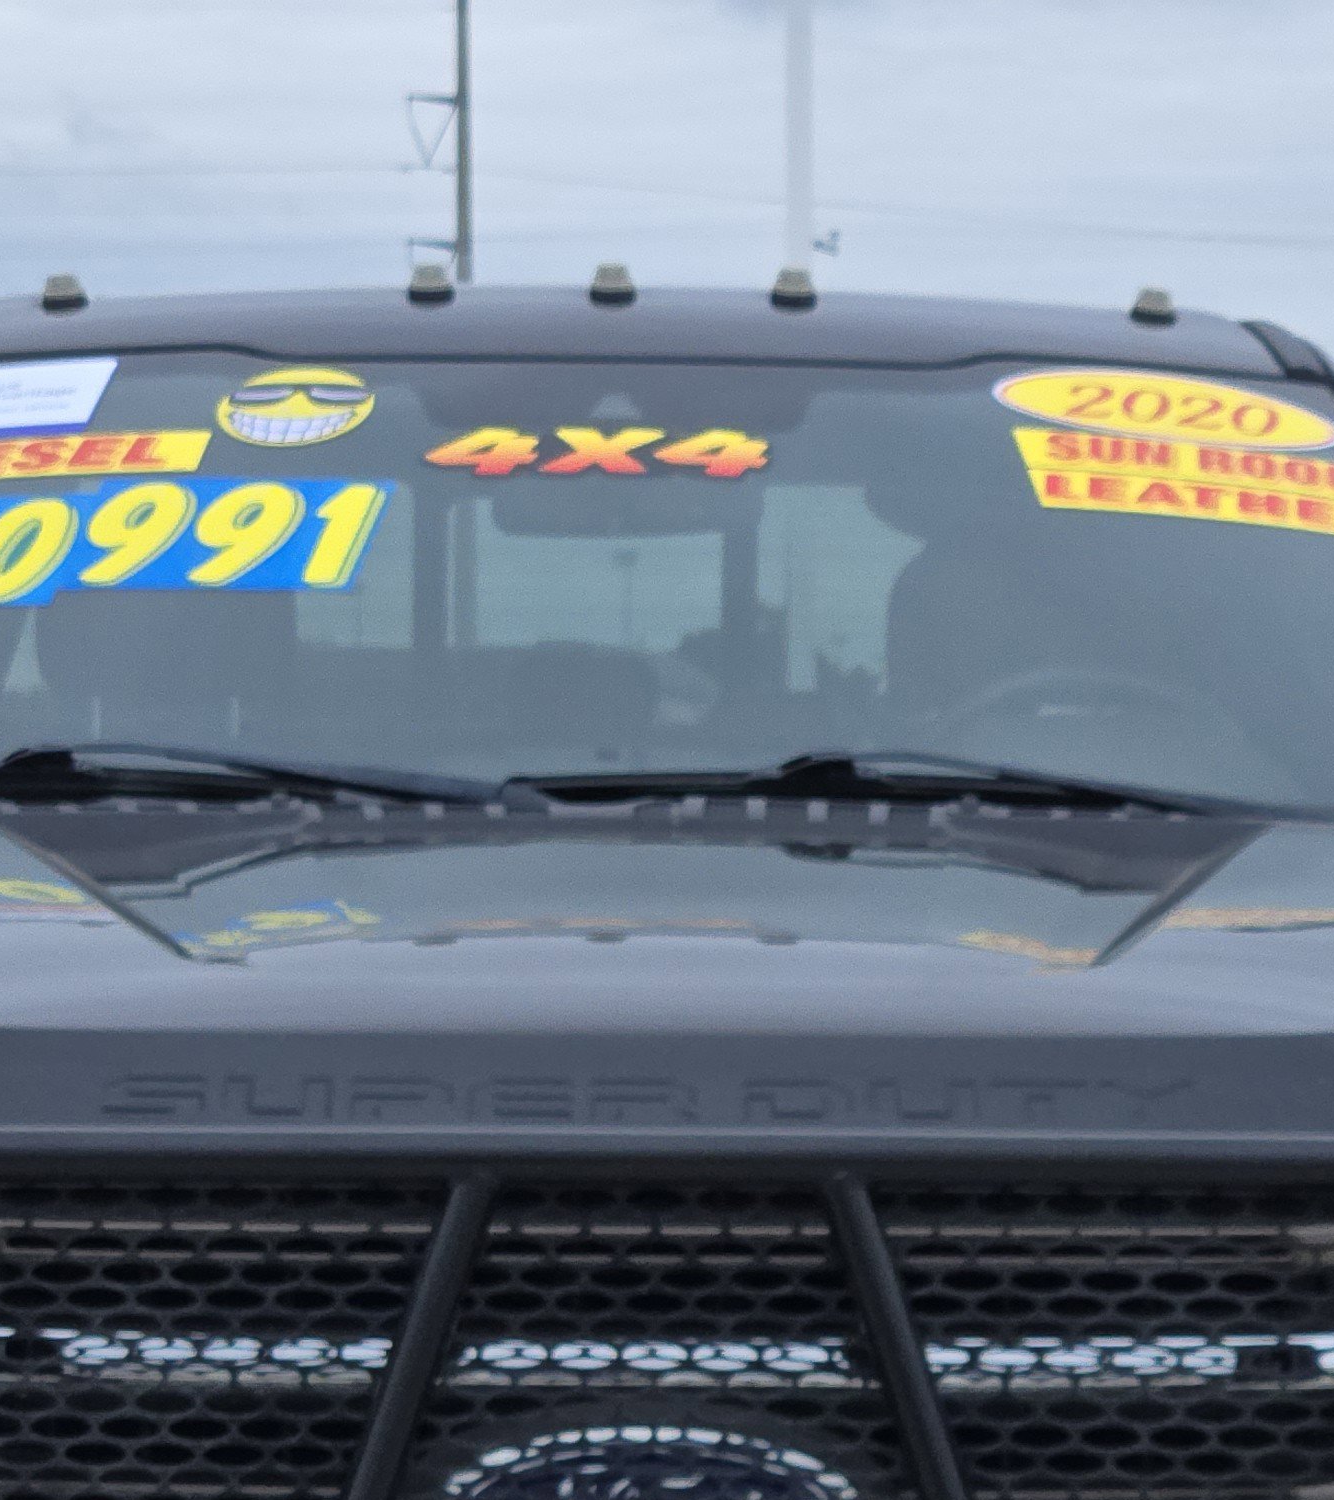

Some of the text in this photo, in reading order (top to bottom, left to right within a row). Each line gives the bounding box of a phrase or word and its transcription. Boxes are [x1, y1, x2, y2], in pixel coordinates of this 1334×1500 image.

[1068, 383, 1281, 437] 2020
[423, 426, 769, 478] 4X4
[1045, 433, 1175, 467] SUN
[102, 1073, 1194, 1122] SUPER DUTY
